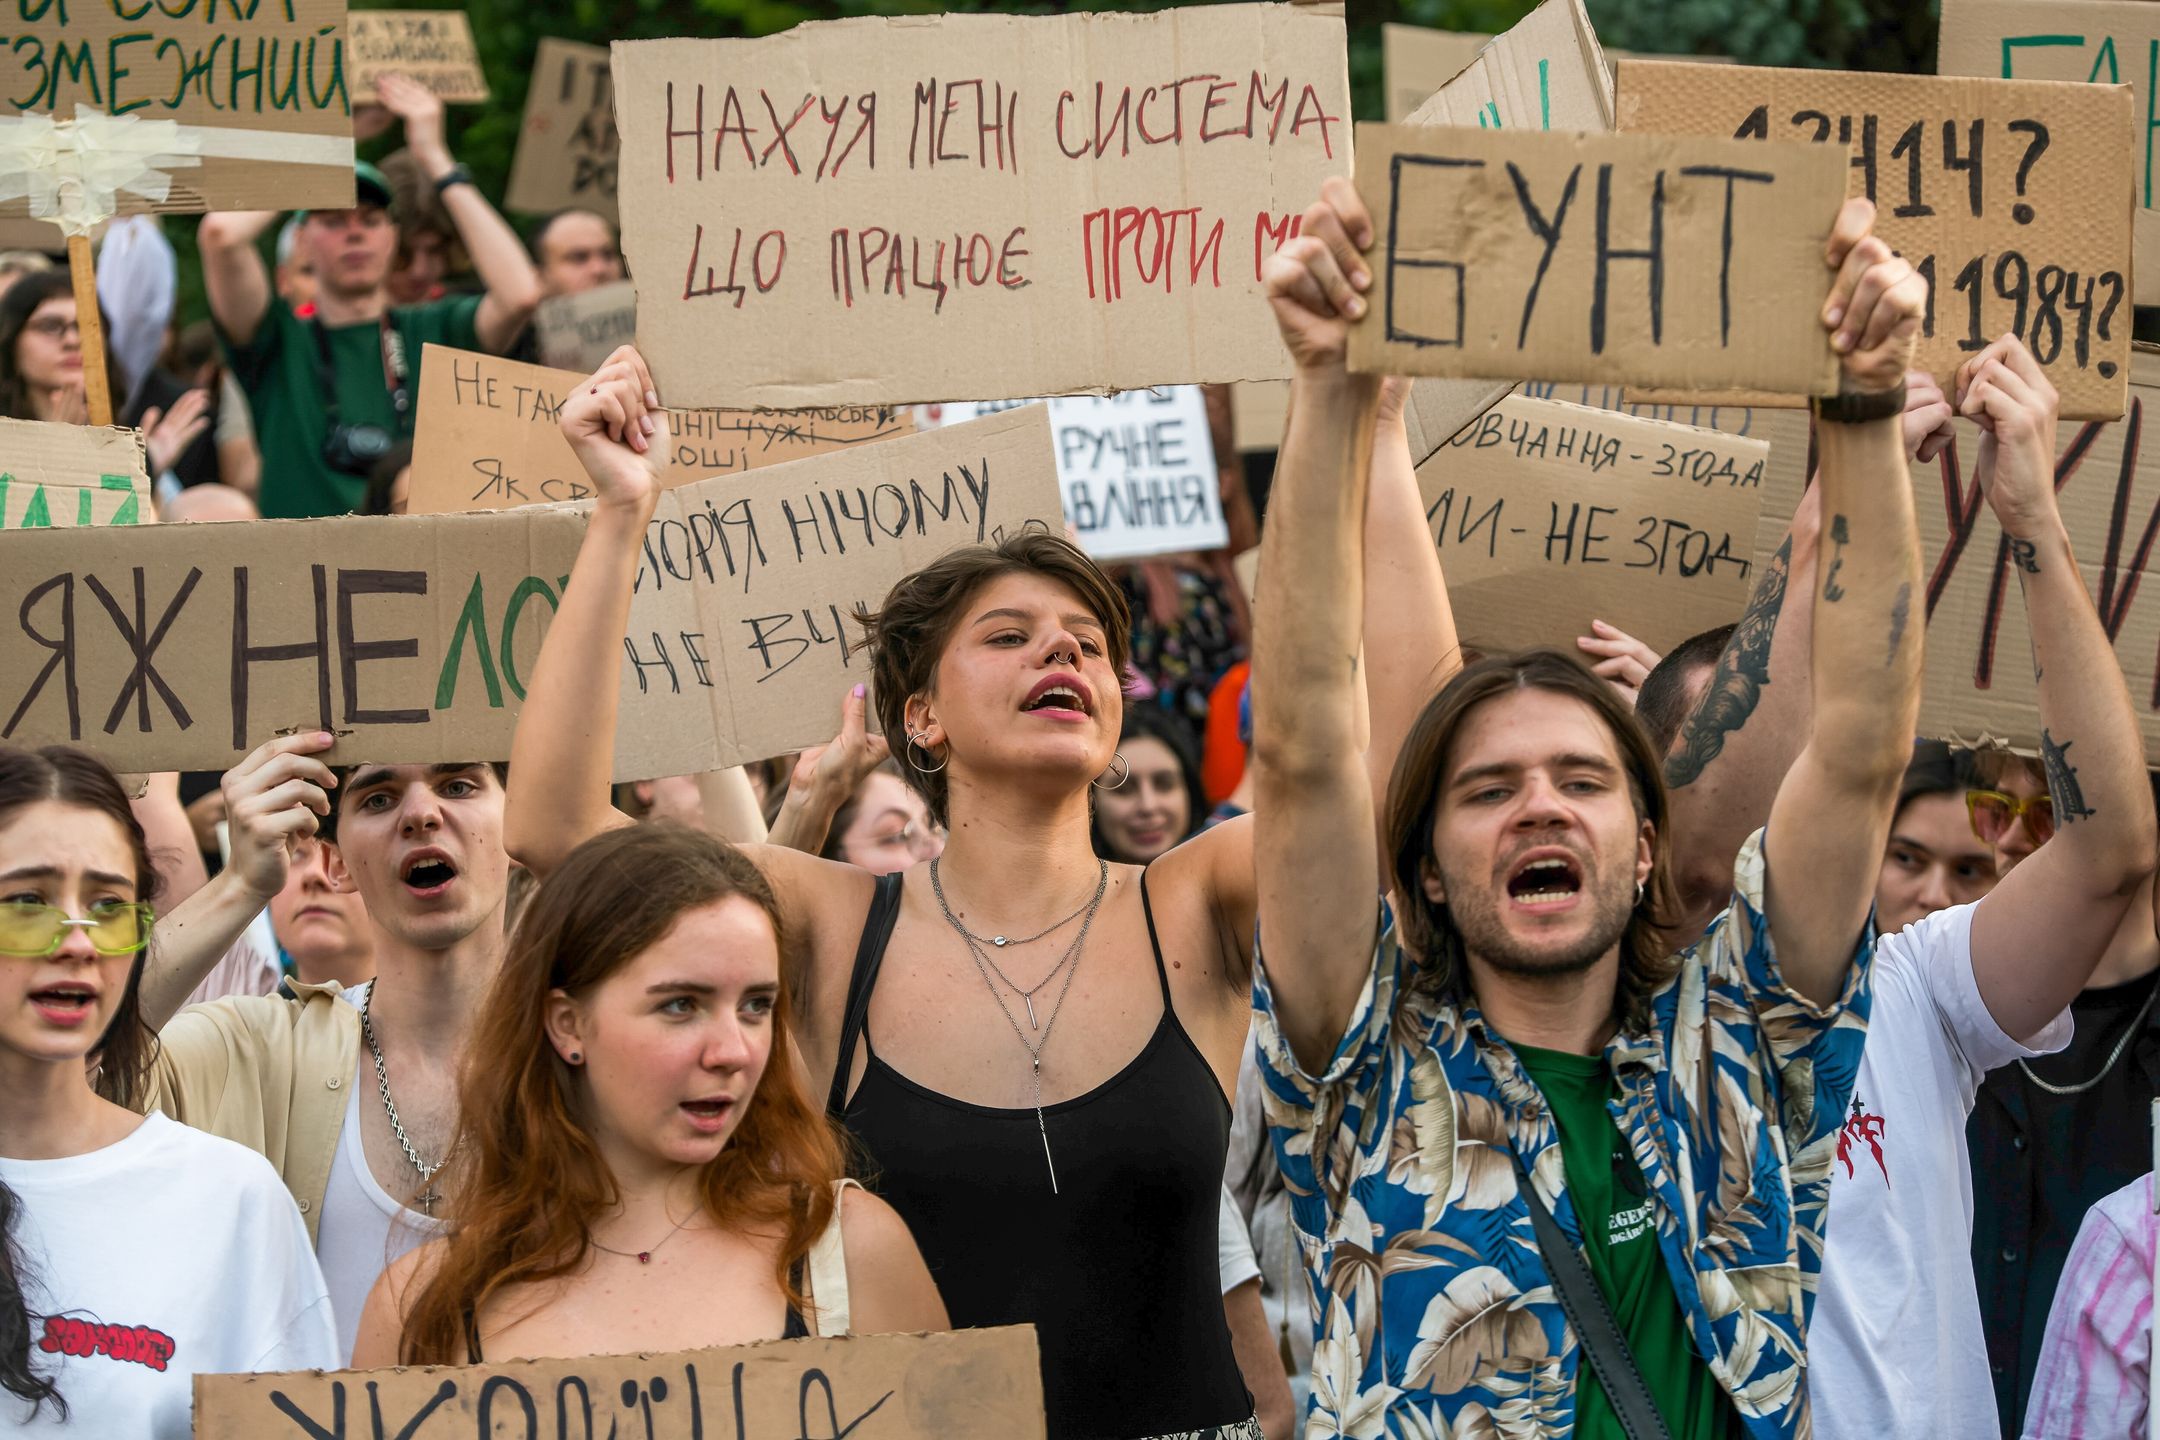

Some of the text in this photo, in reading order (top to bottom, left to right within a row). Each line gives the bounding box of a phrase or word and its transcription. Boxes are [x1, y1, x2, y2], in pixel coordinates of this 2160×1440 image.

[0, 26, 350, 116] ЗМЕЖНИЙ
[666, 81, 875, 183] НАХУЯ
[909, 77, 1017, 175] МЕНІ
[1056, 70, 1339, 159] СИСТЕМА
[683, 224, 786, 309] ЩО
[831, 226, 1032, 314] ПРАЦЮЄ
[1083, 206, 1224, 303] ПРОТИ
[1386, 153, 1775, 355] БУНТ
[454, 359, 501, 408] НЕ
[671, 446, 748, 471] ОШІ
[1059, 420, 1187, 470] РУЧНЕ
[1652, 444, 1766, 487] ЗГОДА
[472, 459, 598, 501] ЯК СВ
[1065, 475, 1213, 531] ВЛІННЯ
[635, 457, 989, 594] ТОРІЯ НІЧОМУ
[1545, 501, 1618, 565] НЕ
[625, 631, 714, 694] НЕ
